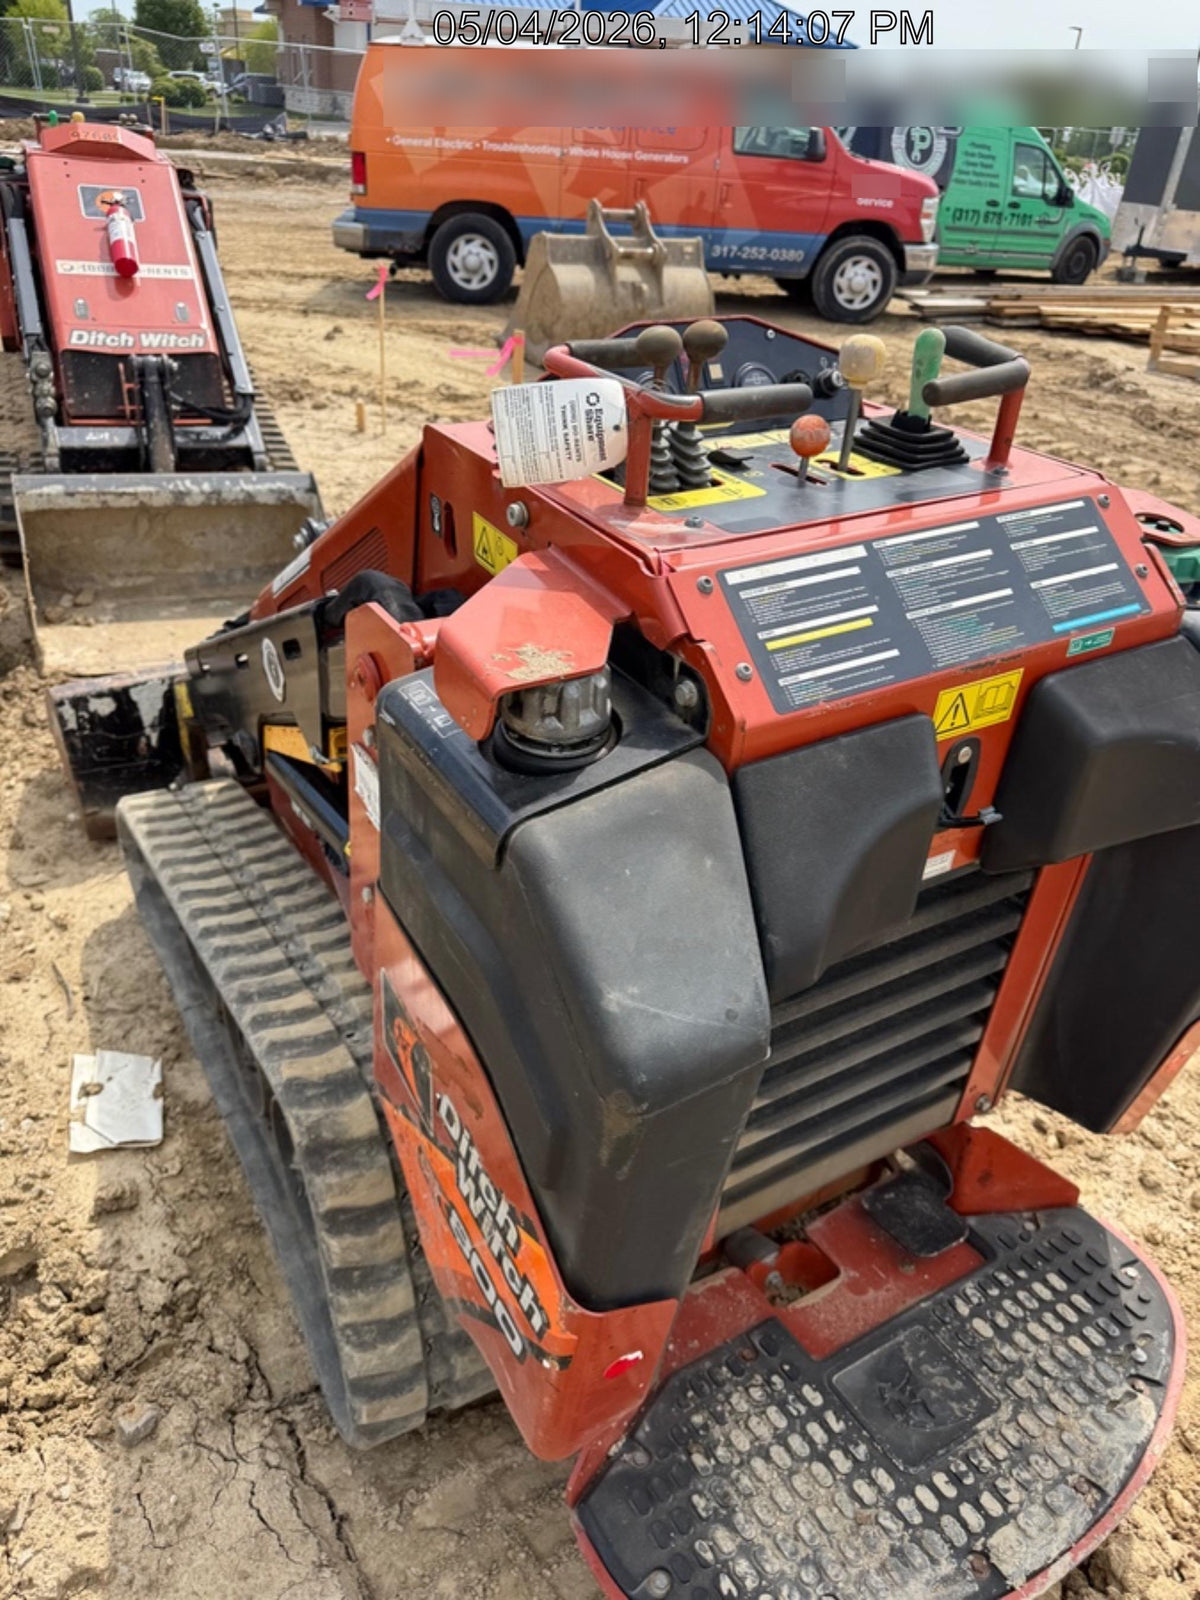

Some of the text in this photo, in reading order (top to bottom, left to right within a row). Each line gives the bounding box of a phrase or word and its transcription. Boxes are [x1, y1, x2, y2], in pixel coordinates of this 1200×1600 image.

[392, 134, 432, 148] General
[434, 138, 473, 150] Electric
[481, 140, 561, 157] Troubleshooting
[568, 147, 599, 158] Whole
[634, 151, 690, 165] Generators
[856, 197, 893, 209] service
[952, 207, 980, 226] (317)
[711, 244, 805, 263] 317-252-0380
[69, 329, 206, 349] Ditch Witch
[585, 408, 595, 442] Share
[594, 407, 607, 462] Equipment
[565, 432, 573, 461] SAFETY
[437, 1093, 516, 1251] Ditch
[458, 1158, 543, 1334] Witch
